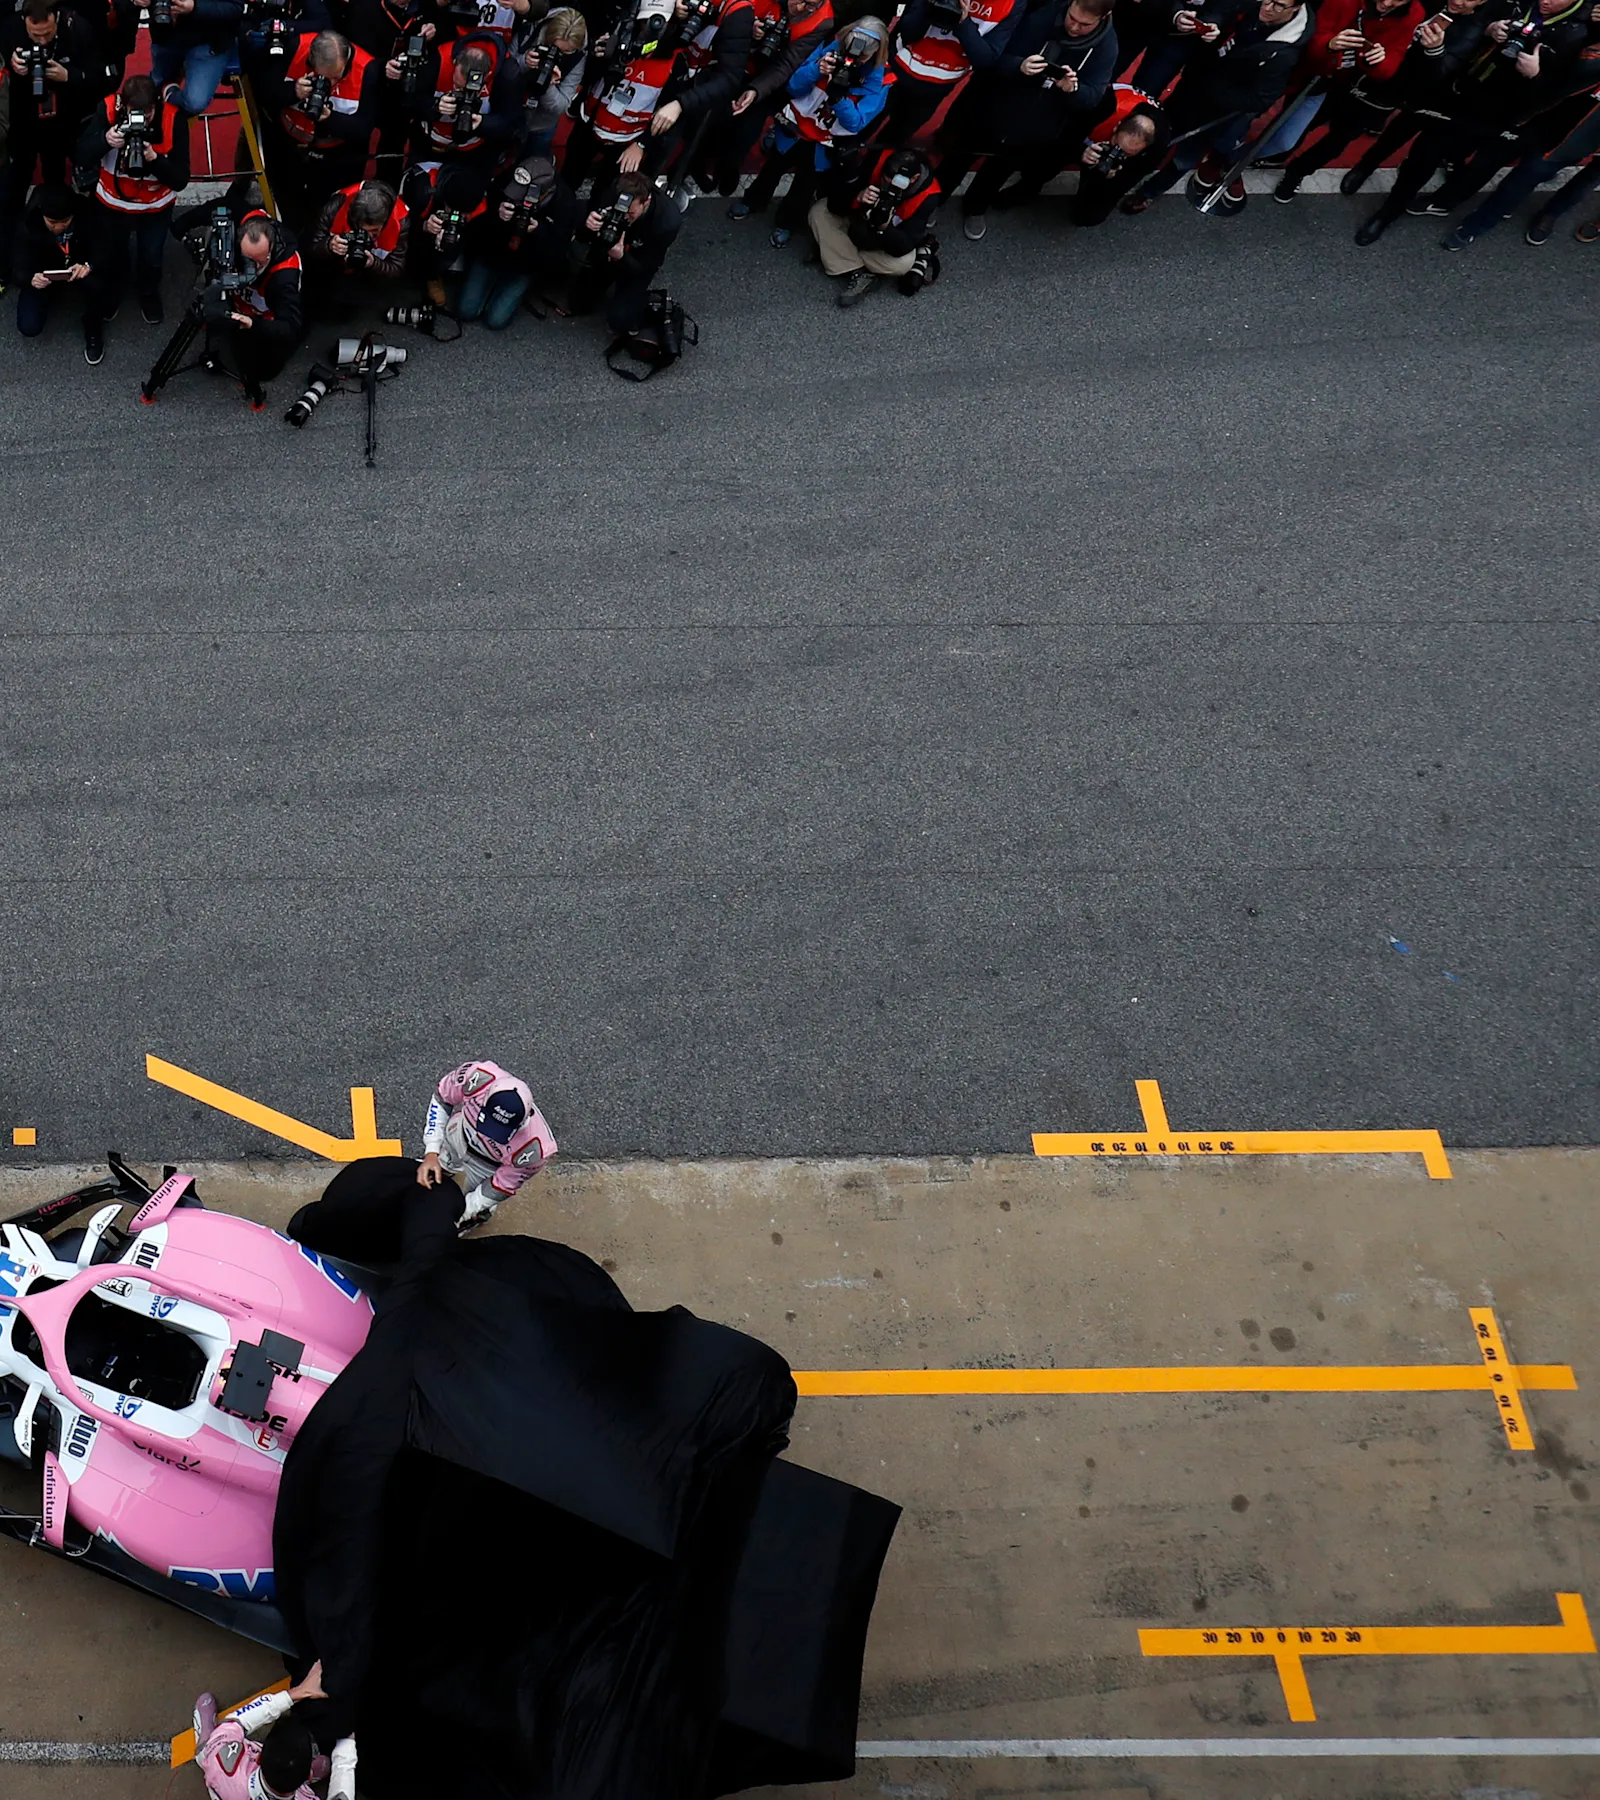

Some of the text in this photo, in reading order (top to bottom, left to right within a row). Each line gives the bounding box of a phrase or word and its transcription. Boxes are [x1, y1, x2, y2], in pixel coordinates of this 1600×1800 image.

[1091, 1142, 1234, 1152] 30 20 10 0 10 20 30
[137, 1178, 179, 1222] infinitum
[136, 1242, 160, 1269] du
[149, 1294, 162, 1317] BWT
[1477, 1323, 1519, 1433] 20 10 0 10 20
[68, 1414, 97, 1458] duo
[46, 1465, 57, 1529] infinitum
[1202, 1632, 1361, 1643] 30 20 10 0 10 20 30
